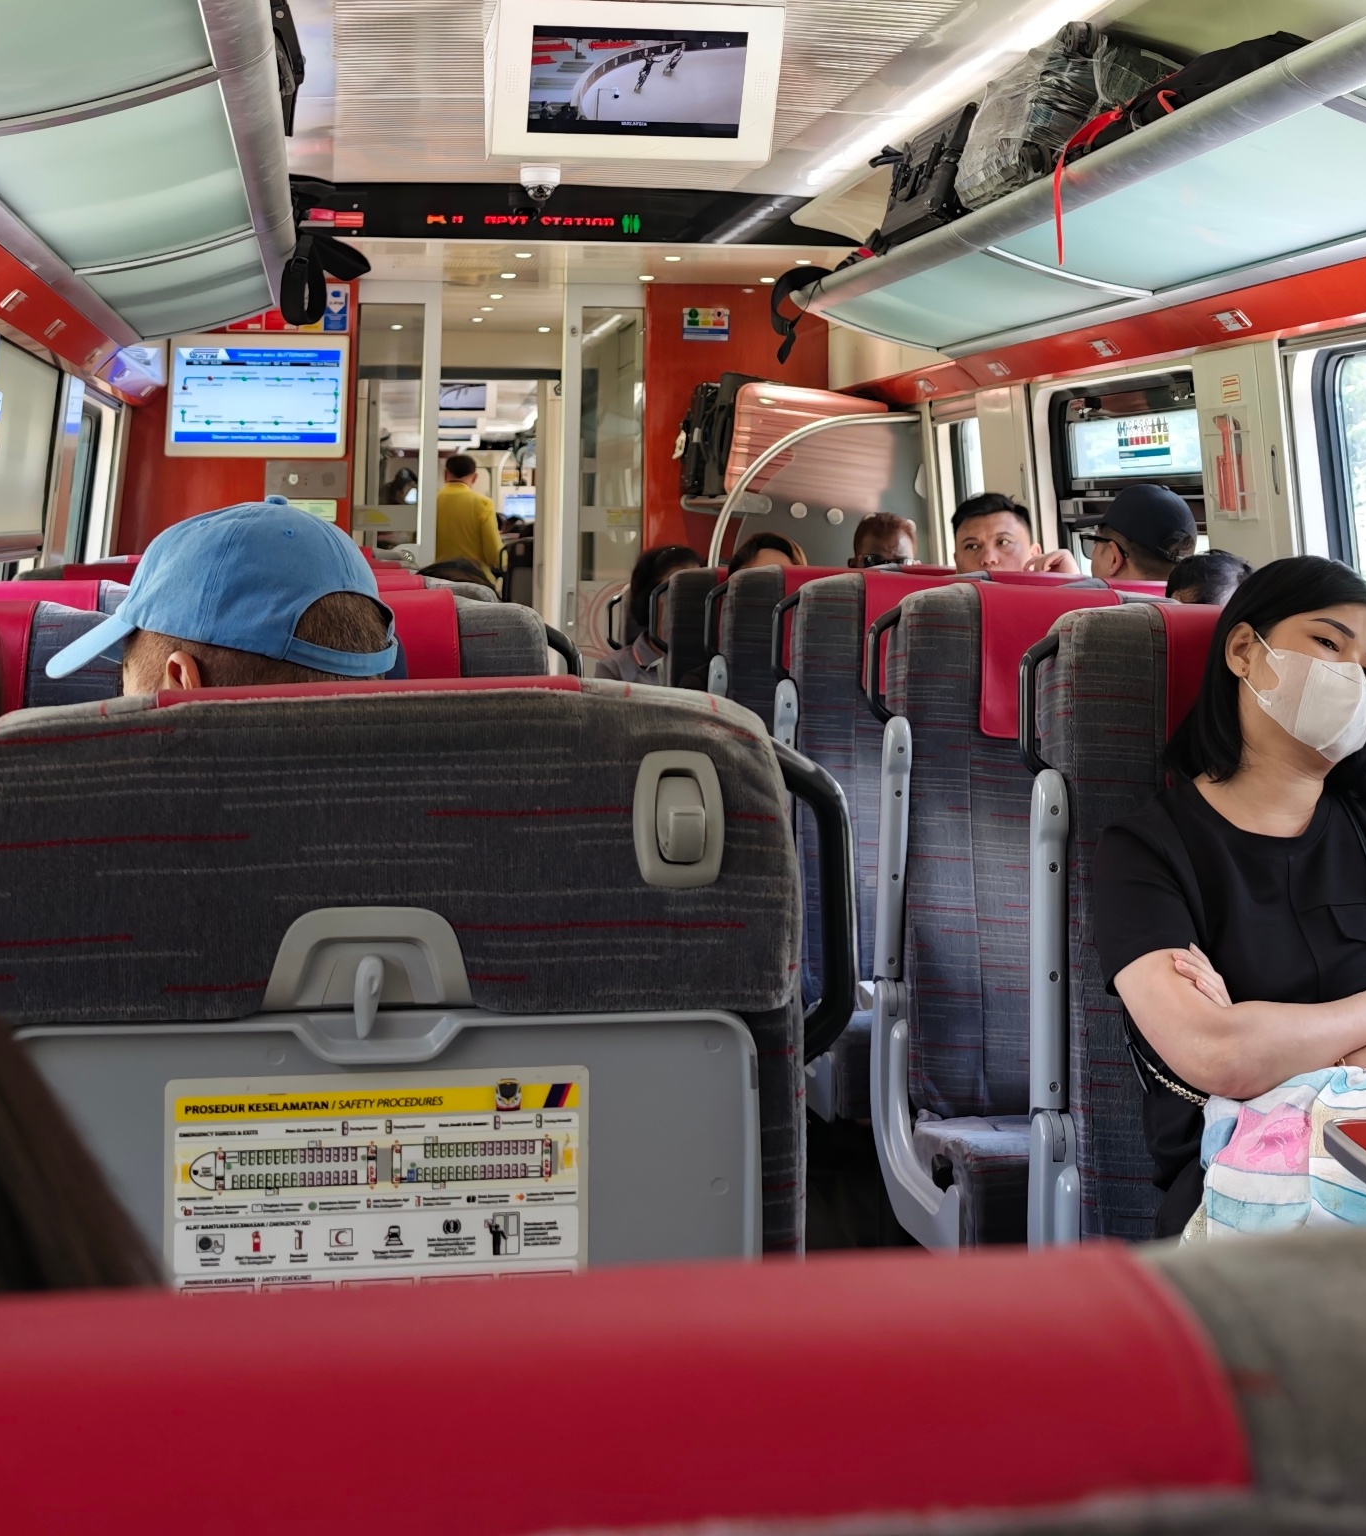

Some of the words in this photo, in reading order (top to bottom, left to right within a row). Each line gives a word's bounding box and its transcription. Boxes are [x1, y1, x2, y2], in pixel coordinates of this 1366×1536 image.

[184, 1102, 246, 1115] PROSEDUR
[248, 1100, 329, 1113] KESELAMATAN
[337, 1097, 375, 1110] SAFETY
[377, 1095, 444, 1108] PROCEDURES
